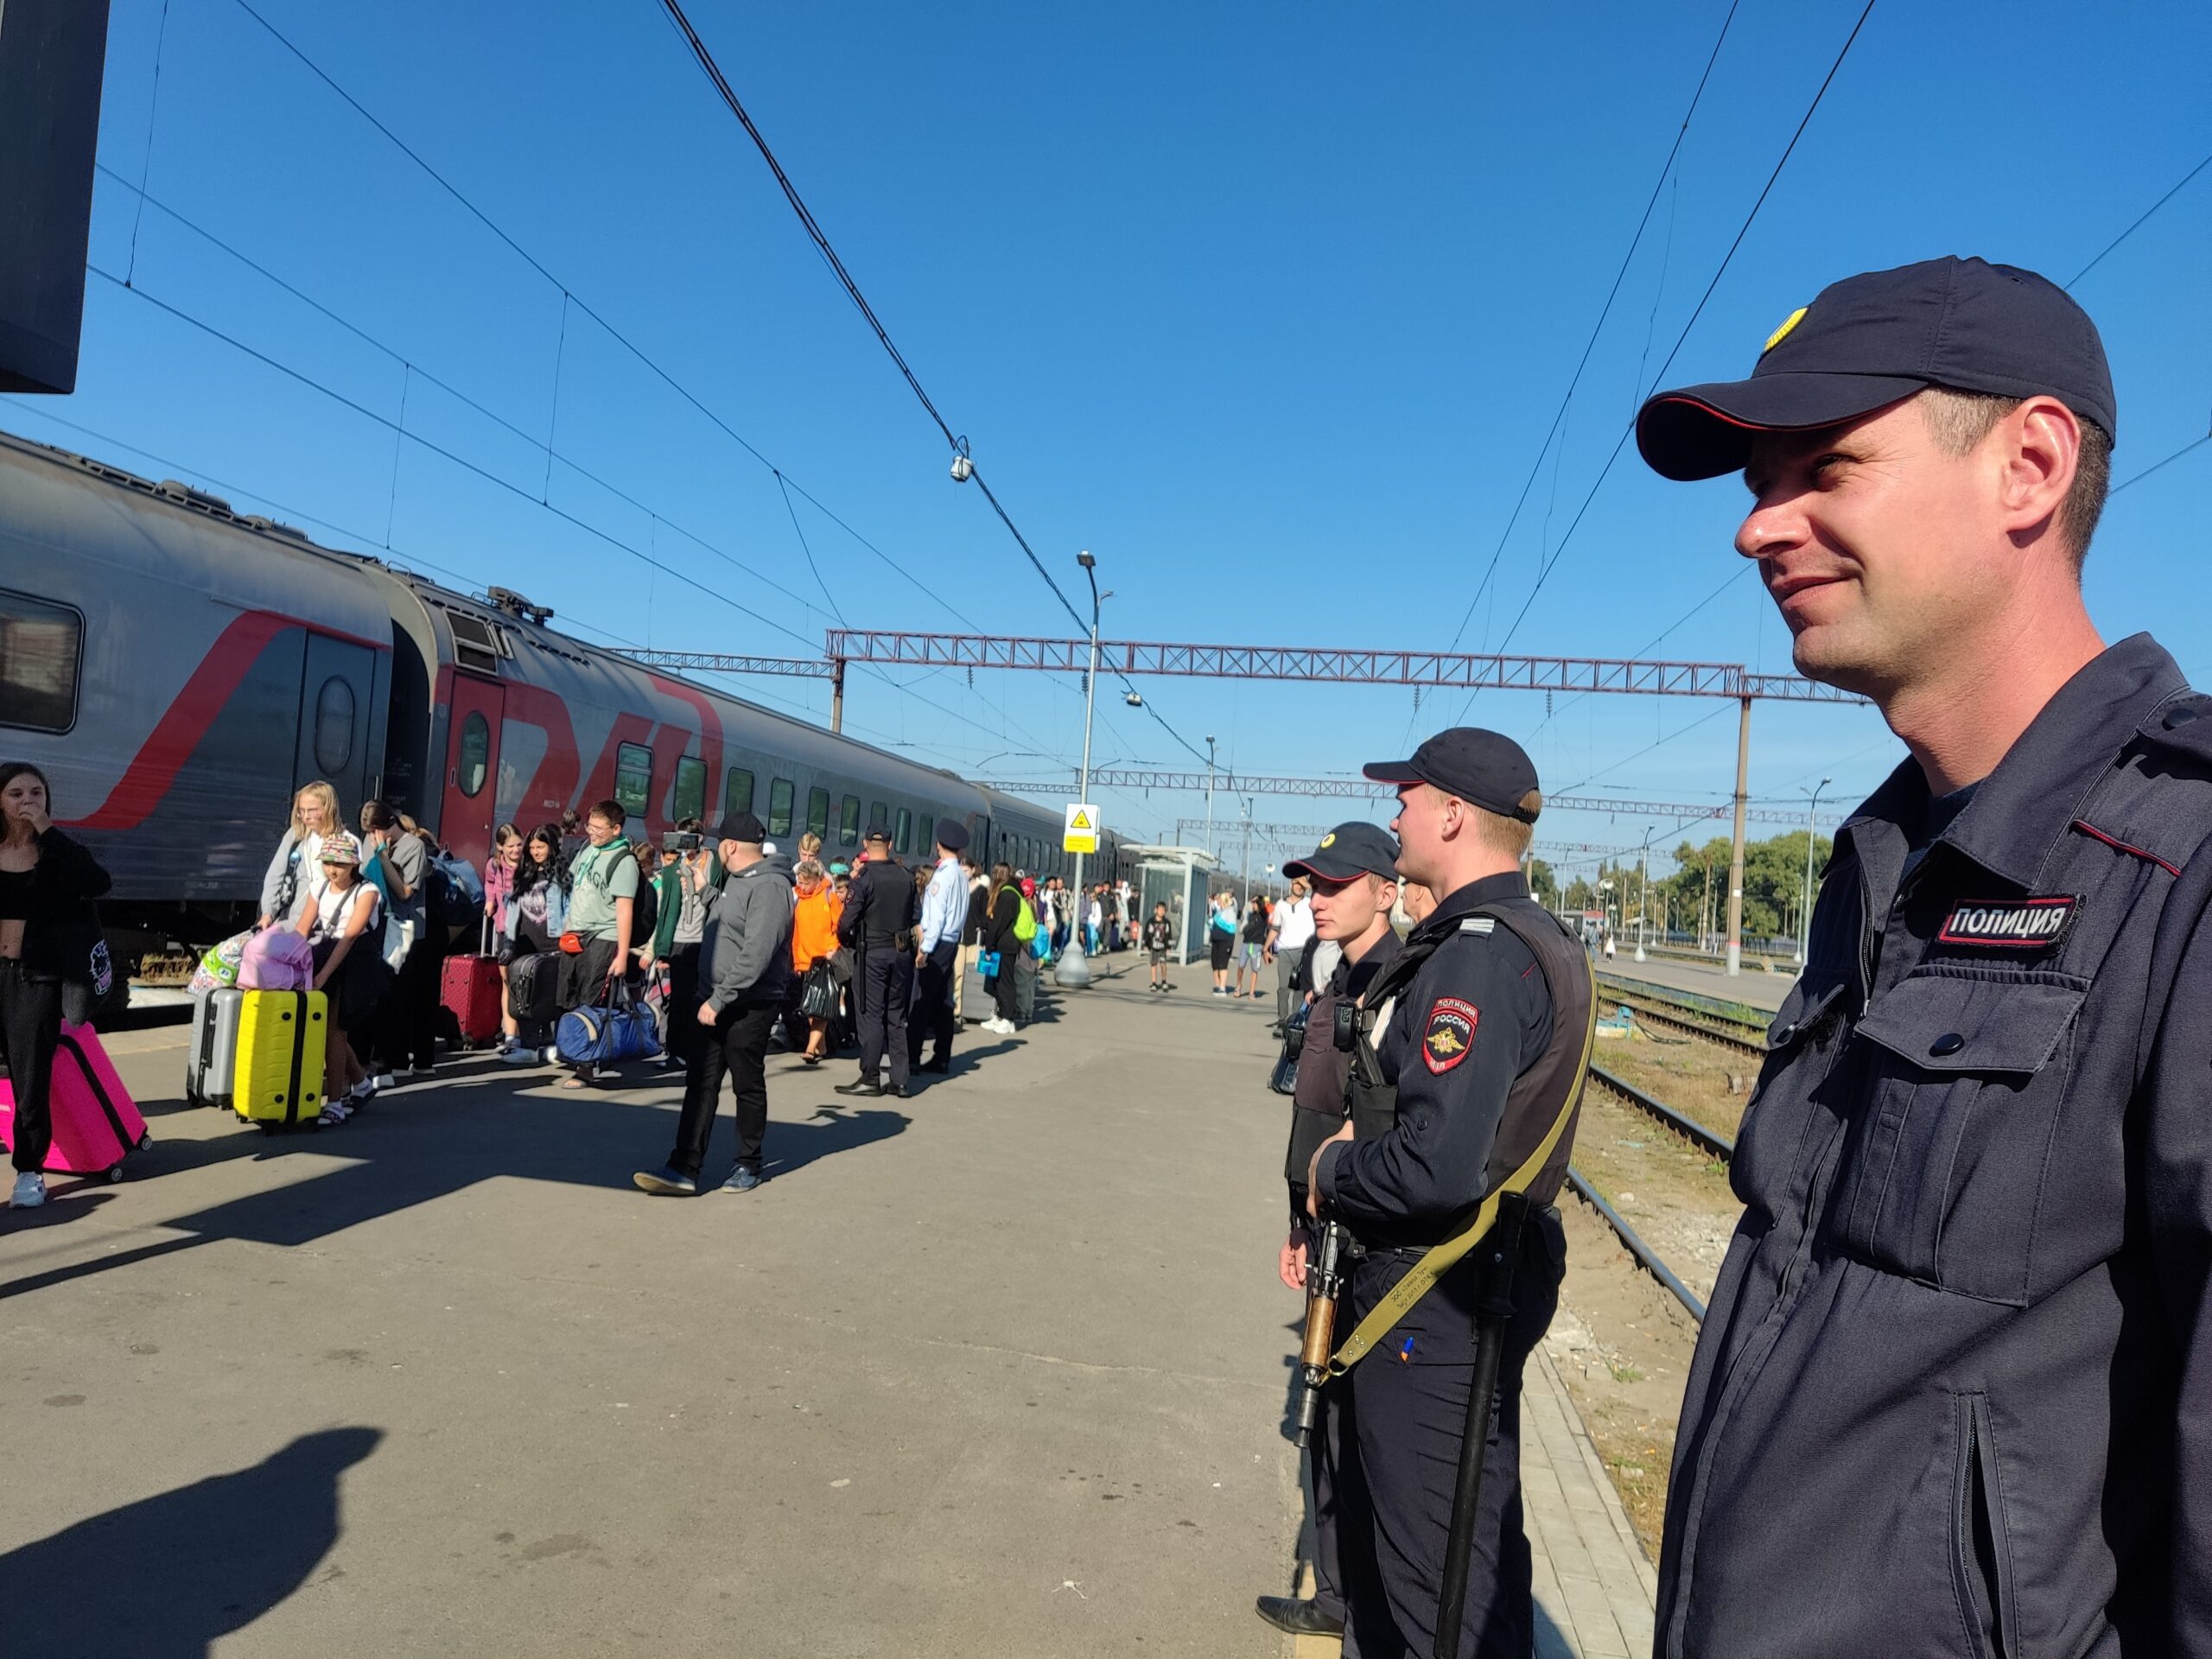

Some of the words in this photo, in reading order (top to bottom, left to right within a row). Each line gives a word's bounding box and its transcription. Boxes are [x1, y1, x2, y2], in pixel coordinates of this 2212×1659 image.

[1950, 907, 2066, 938] ПОЛИЦИЯ
[1437, 1000, 1476, 1017] ПОЛИЦИЯ
[1433, 1014, 1471, 1034] РОССИЯ
